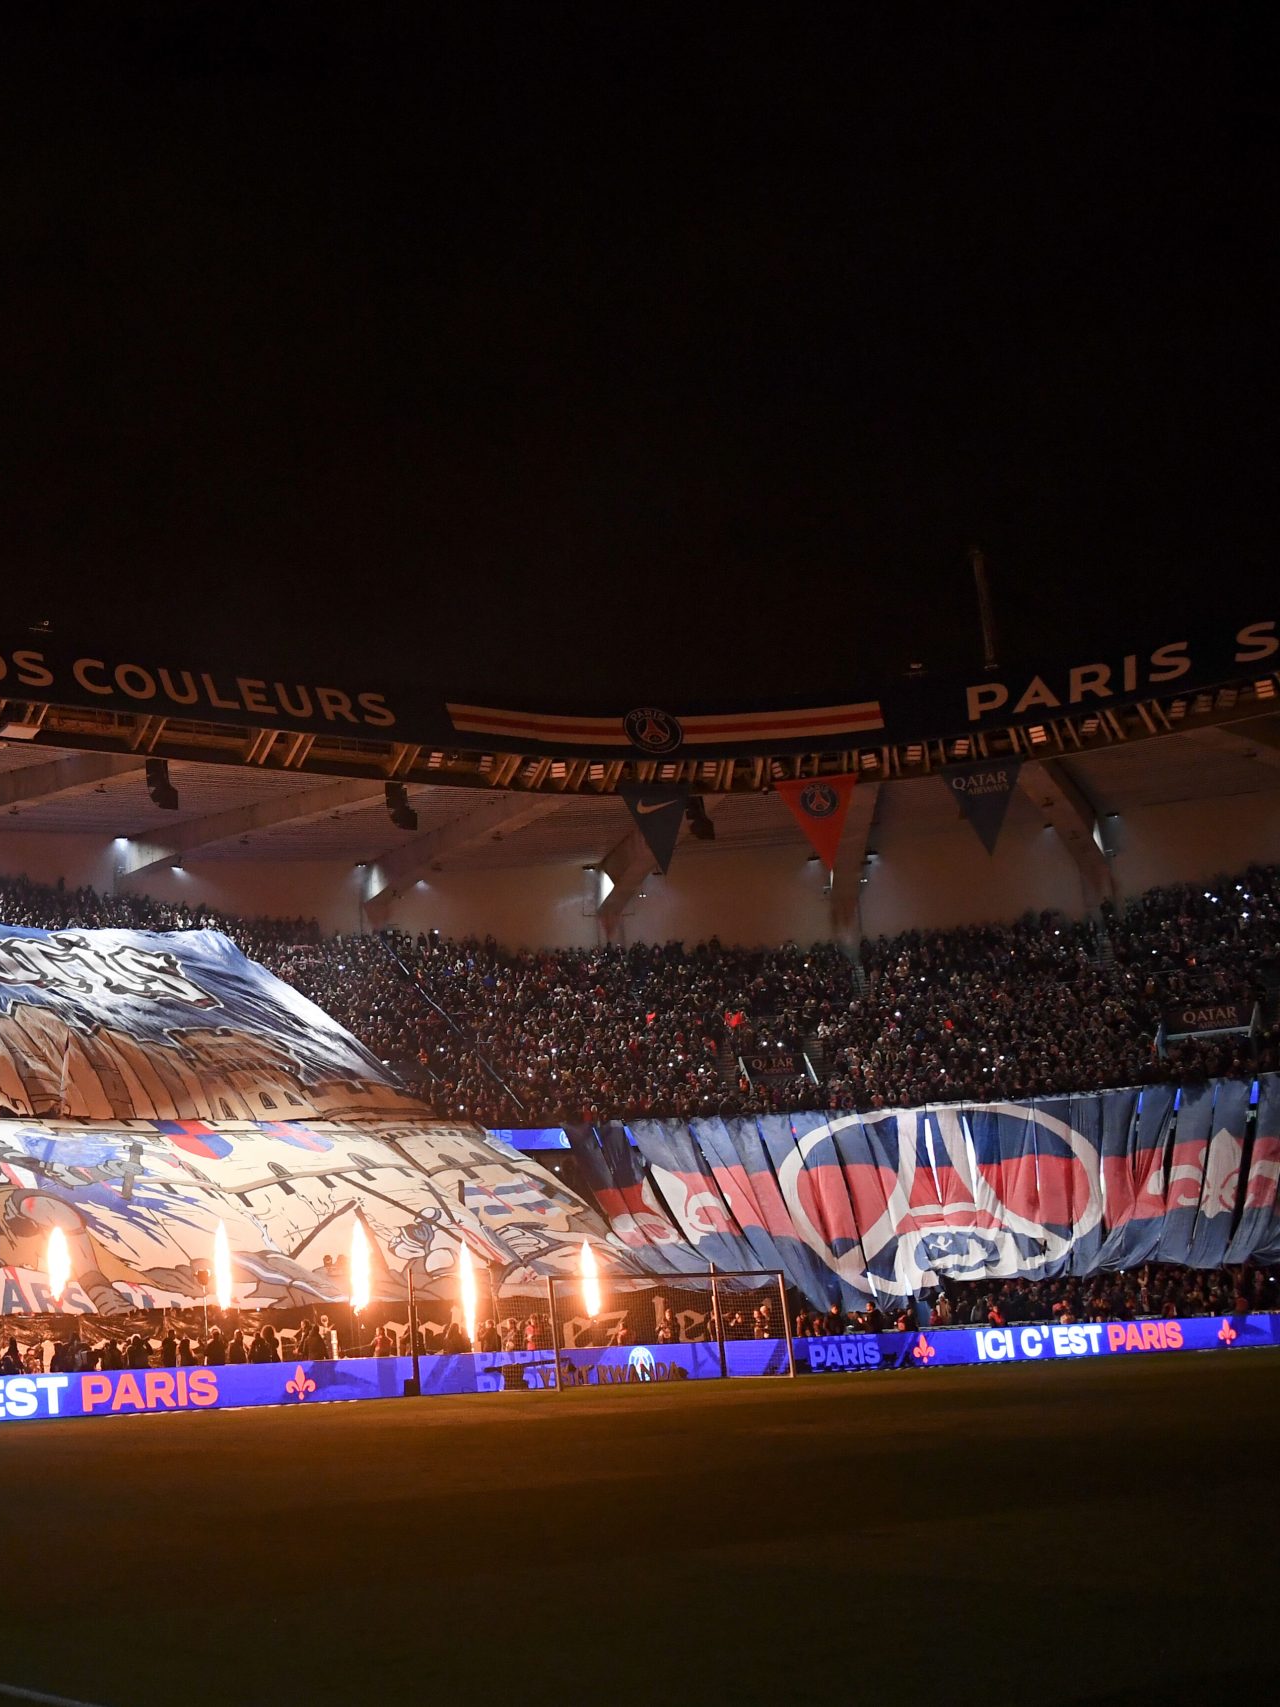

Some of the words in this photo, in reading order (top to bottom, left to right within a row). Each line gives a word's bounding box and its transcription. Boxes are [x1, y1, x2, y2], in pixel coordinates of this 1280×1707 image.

[73, 658, 396, 727] COULEURS
[966, 641, 1192, 721] PARIS
[952, 770, 1008, 791] QATAR
[1182, 1006, 1238, 1025] QATAR
[808, 1342, 880, 1368] PARIS
[976, 1328, 1014, 1359] ICI
[1021, 1325, 1102, 1356] C'EST
[1107, 1321, 1184, 1351] PARIS
[81, 1369, 219, 1412] PARIS
[537, 1364, 594, 1388] VSIT
[597, 1361, 681, 1385] RWANDA
